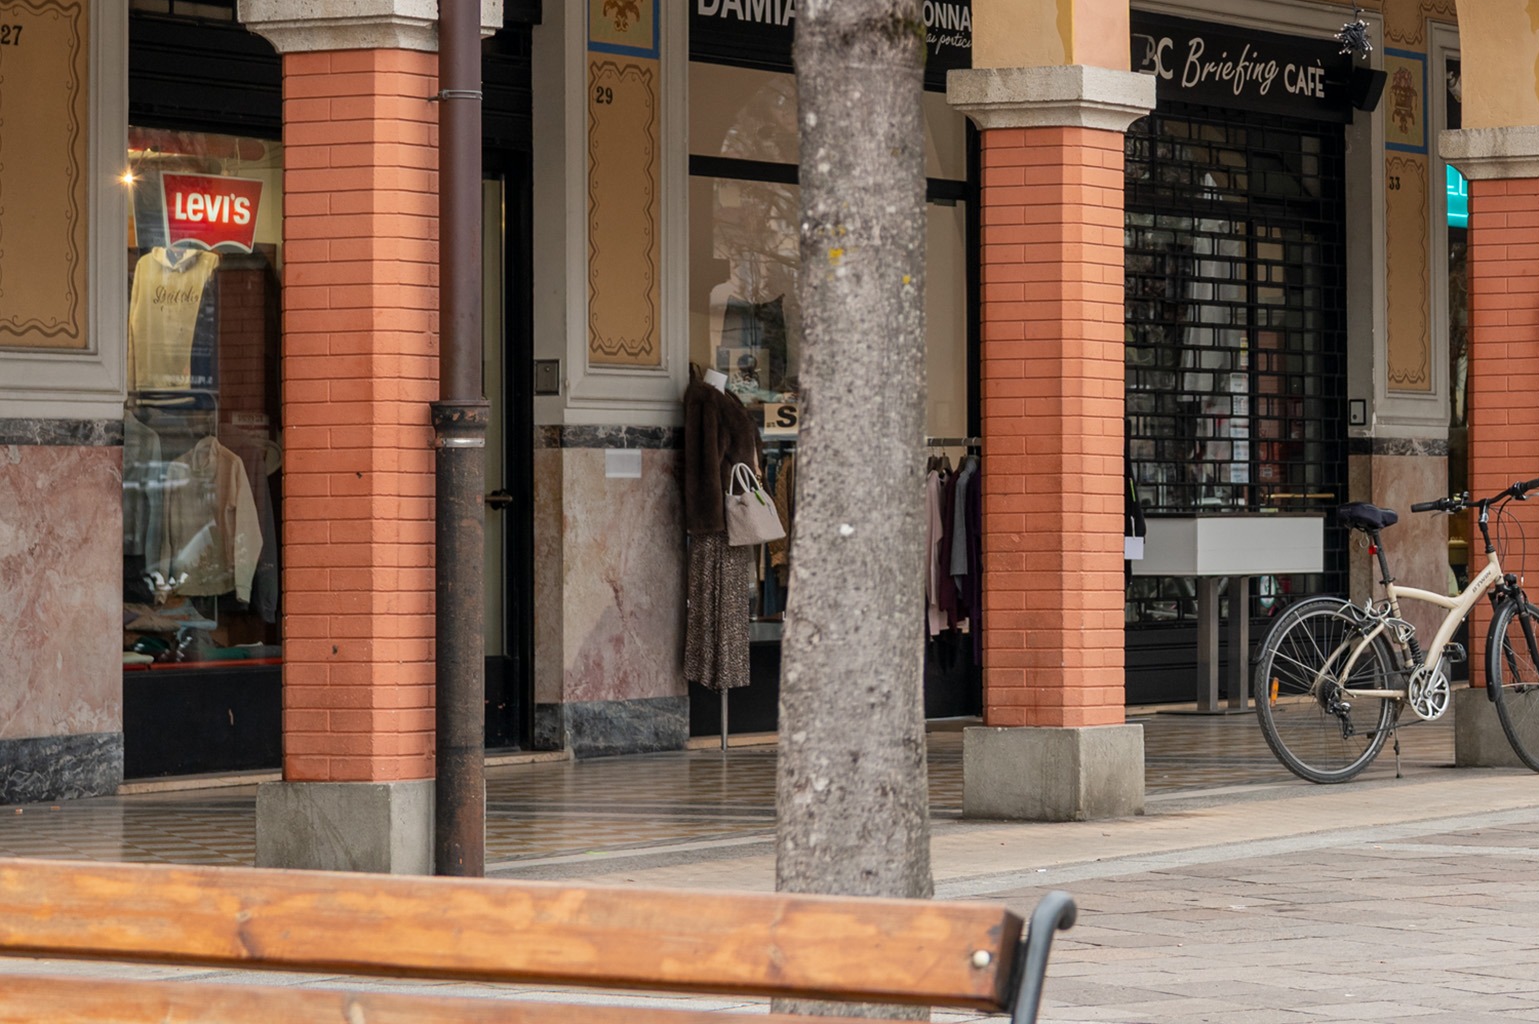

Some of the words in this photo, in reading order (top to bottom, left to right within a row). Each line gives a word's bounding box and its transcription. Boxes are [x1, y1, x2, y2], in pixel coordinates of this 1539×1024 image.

[922, 0, 972, 32] ONNA
[0, 24, 23, 46] 27
[1181, 37, 1280, 96] Briefing
[1284, 58, 1325, 98] CAFÈ
[596, 86, 613, 105] 29
[1389, 176, 1401, 191] 33
